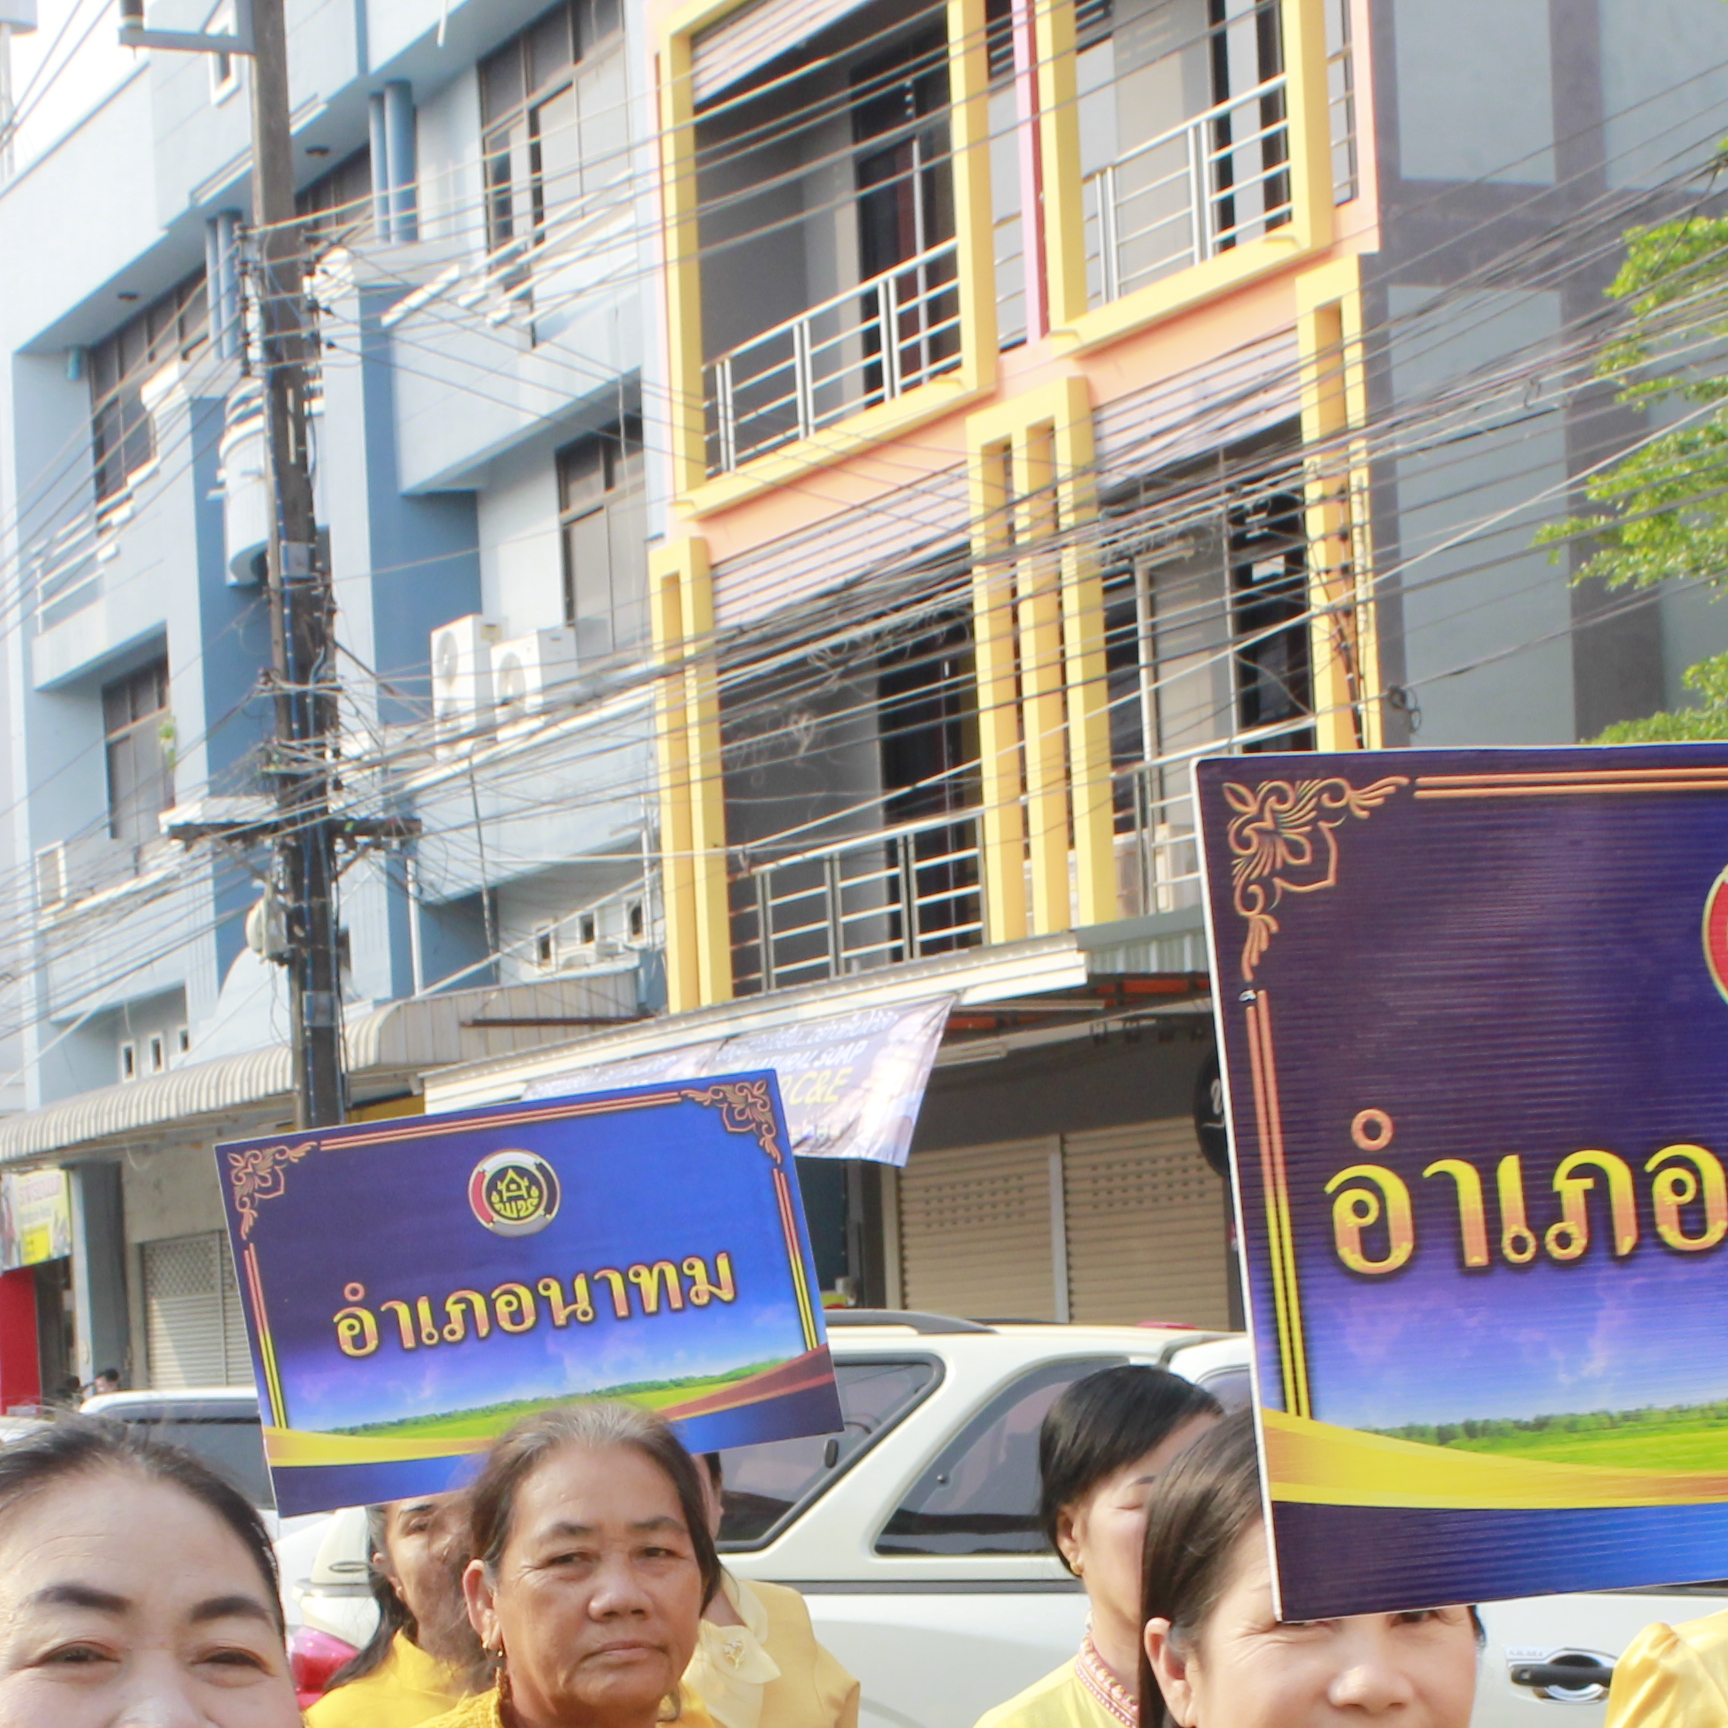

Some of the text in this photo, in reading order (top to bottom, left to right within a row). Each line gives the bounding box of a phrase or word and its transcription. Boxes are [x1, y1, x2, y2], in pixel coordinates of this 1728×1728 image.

[813, 1040, 869, 1068] SOAP
[333, 1252, 735, 1356] อำเภอนาทม
